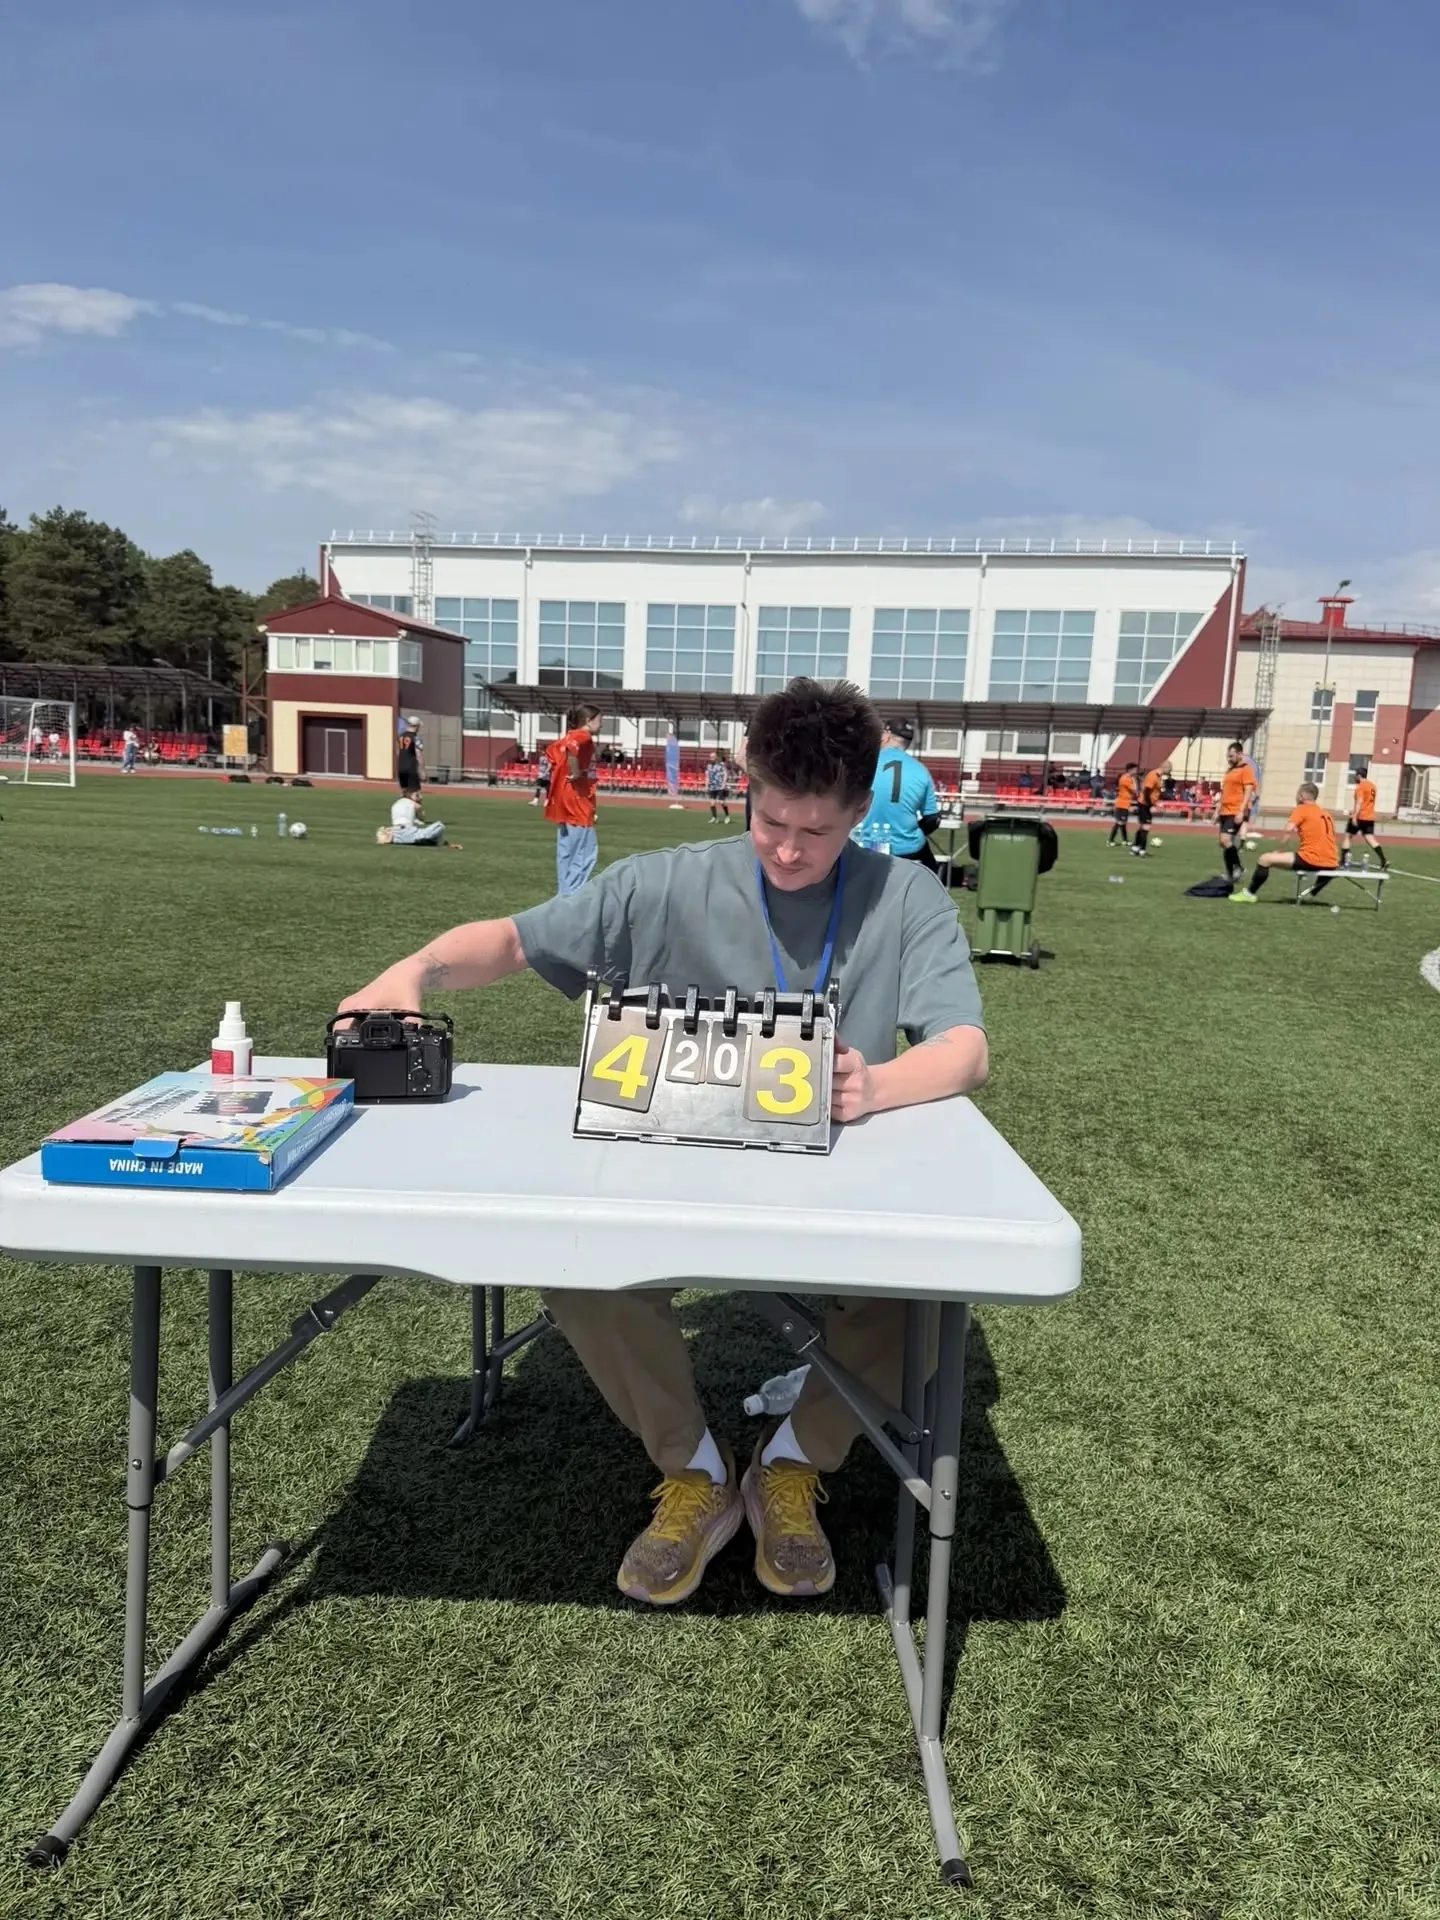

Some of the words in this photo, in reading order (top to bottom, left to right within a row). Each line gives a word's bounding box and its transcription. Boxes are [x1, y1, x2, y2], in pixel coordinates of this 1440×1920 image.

[883, 760, 902, 803] 1
[1320, 815, 1335, 836] 11
[592, 1035, 649, 1099] 4
[756, 1047, 814, 1116] 3
[109, 1159, 146, 1173] CHINA
[150, 1161, 164, 1173] IN
[168, 1162, 204, 1175] MADE
